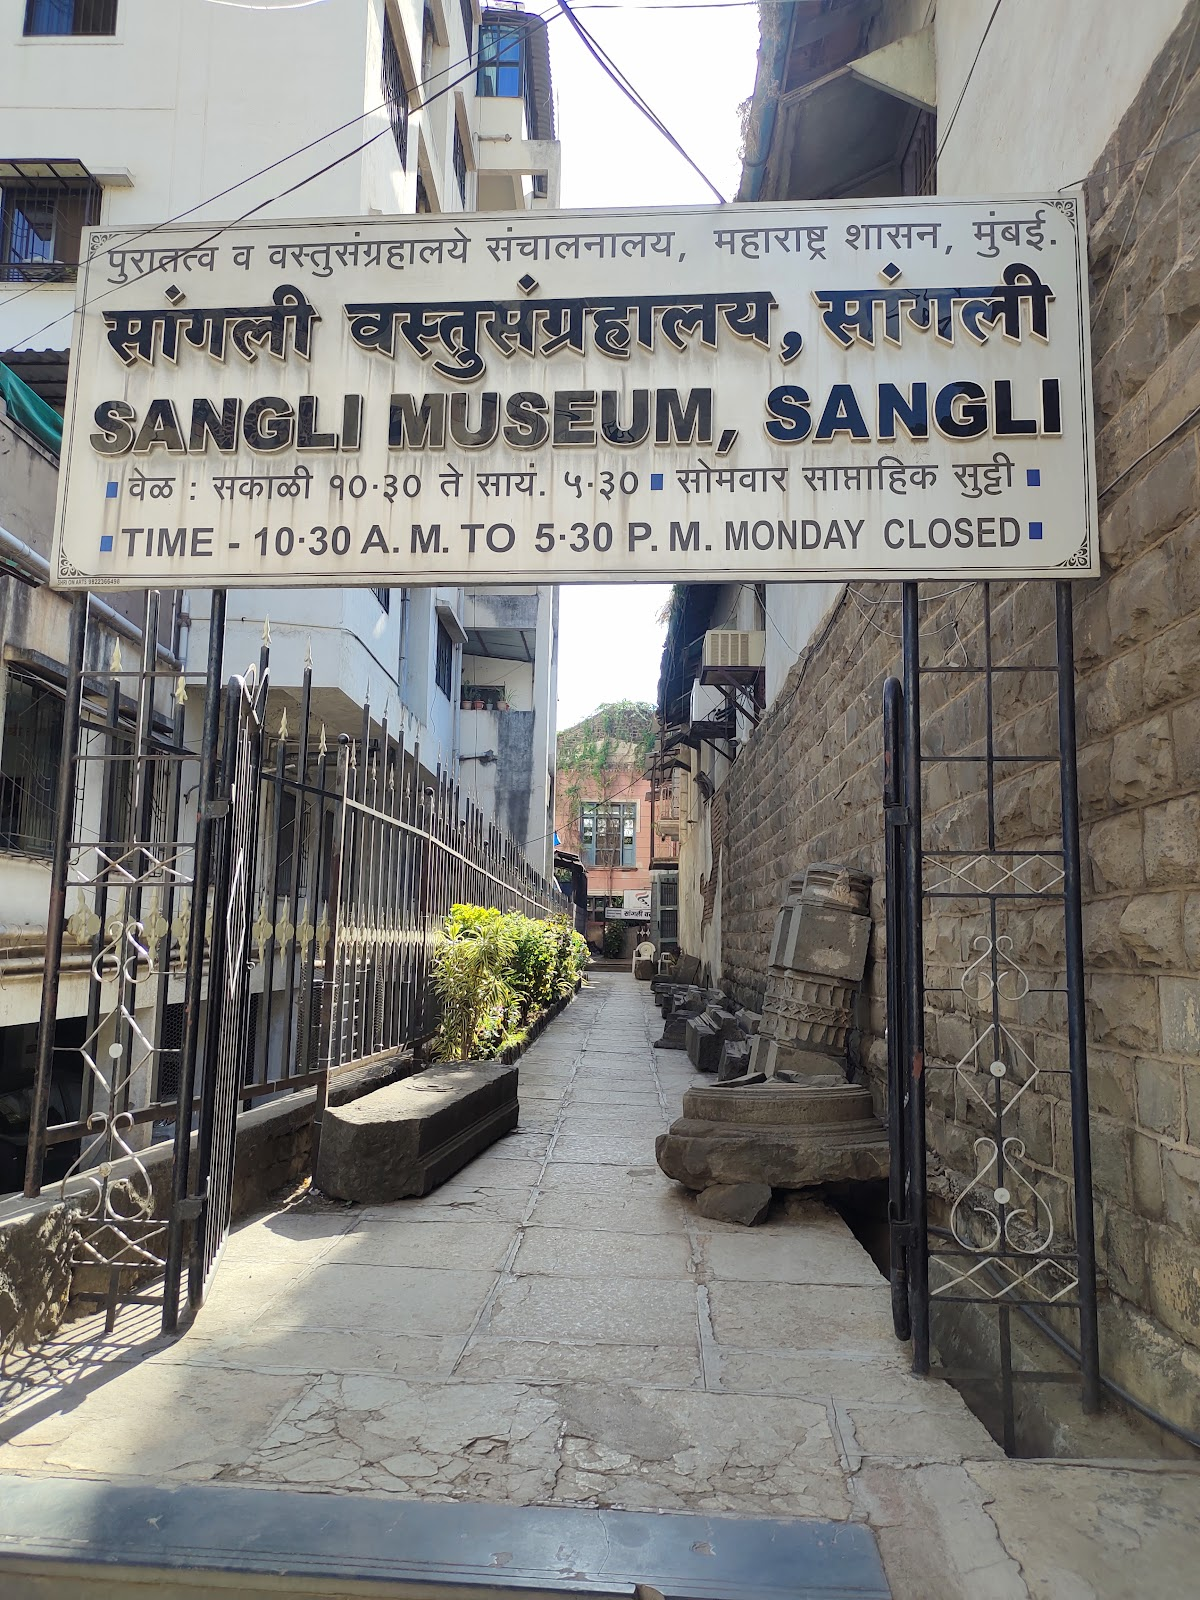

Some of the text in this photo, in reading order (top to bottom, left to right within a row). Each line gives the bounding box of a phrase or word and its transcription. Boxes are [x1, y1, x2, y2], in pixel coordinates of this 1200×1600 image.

[107, 245, 221, 284] पुरातत्व
[232, 245, 256, 271] व
[713, 225, 828, 261] महाराष्ट्र
[101, 283, 323, 367] सांगली
[810, 262, 1056, 350] सांगली
[89, 393, 364, 458] SANGLI
[764, 379, 1064, 445] SANGLI
[212, 465, 314, 501] सकाळी
[439, 463, 464, 498] ते
[676, 459, 788, 495] सोमवार
[121, 527, 215, 557] TIME
[461, 523, 516, 554] TO
[725, 518, 865, 551] MONDAY
[883, 516, 1021, 550] CLOSED
